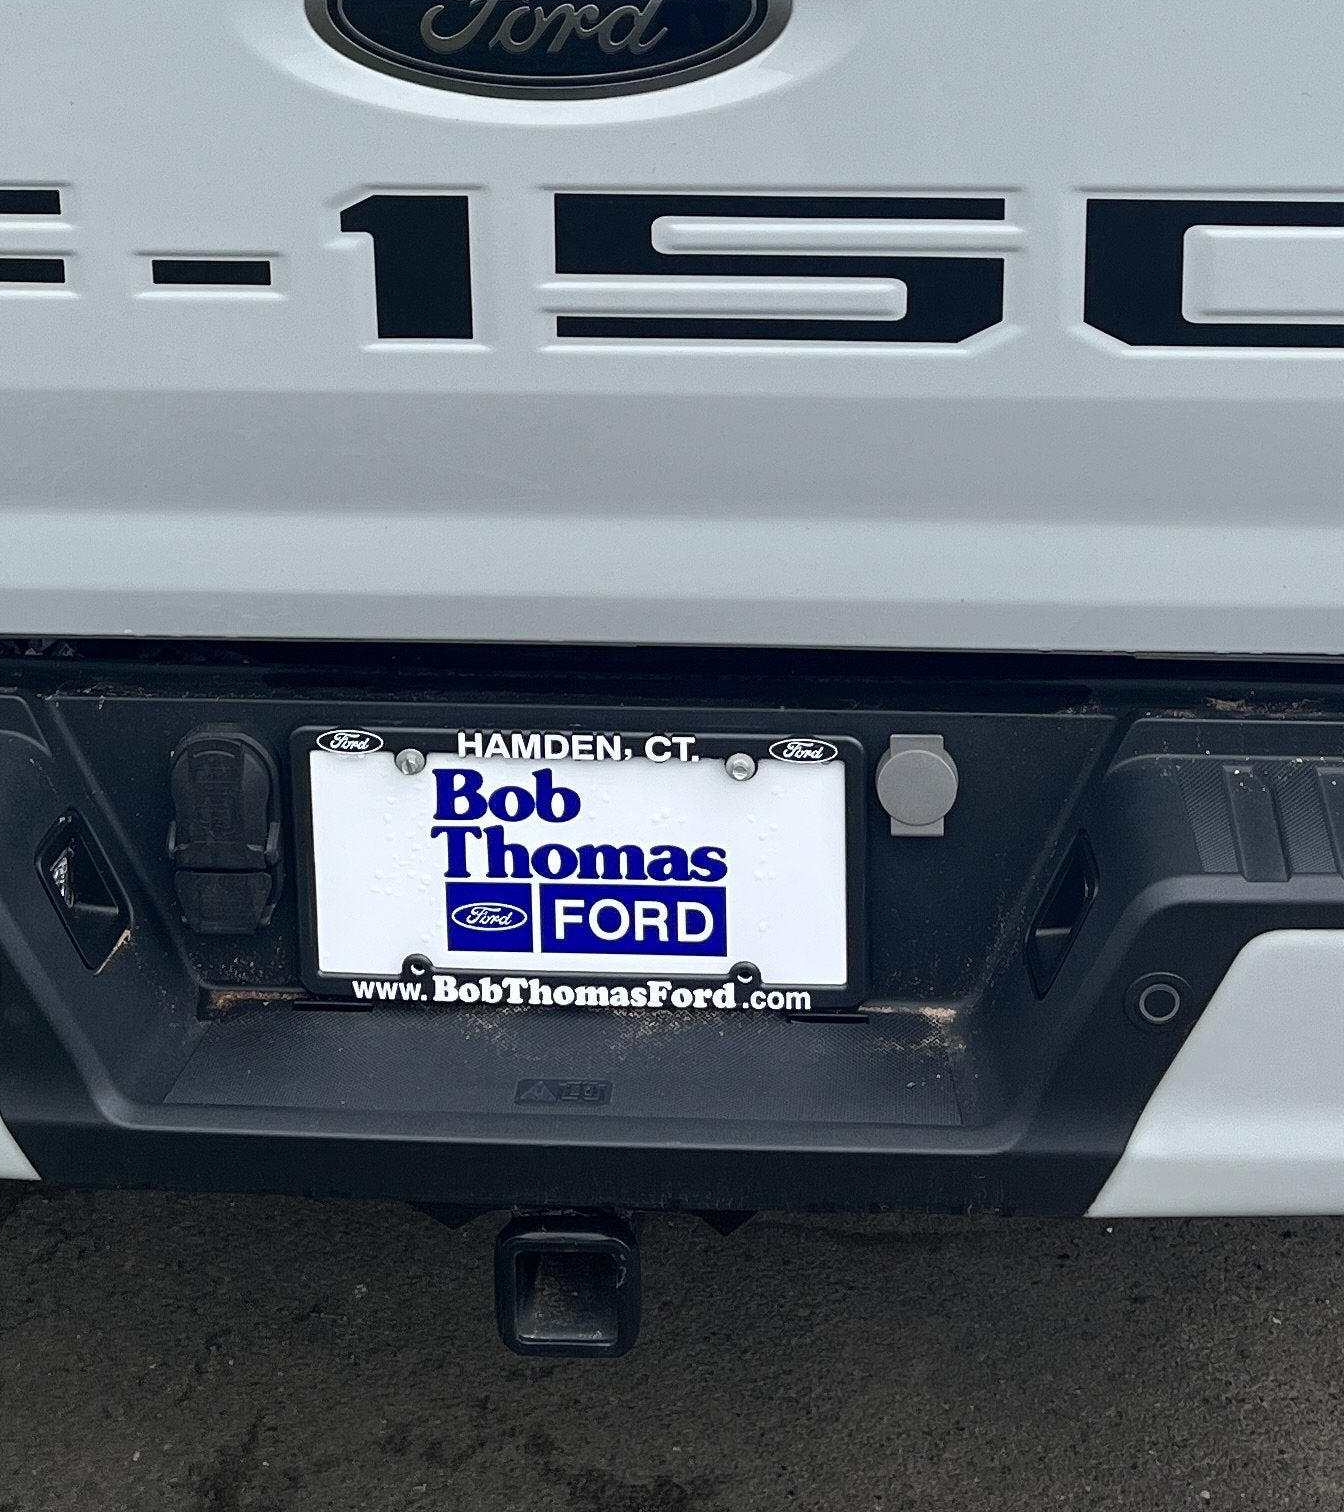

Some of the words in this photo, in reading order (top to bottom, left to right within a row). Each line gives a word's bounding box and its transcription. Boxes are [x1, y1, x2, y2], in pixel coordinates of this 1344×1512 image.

[329, 732, 370, 751] Ford
[457, 732, 634, 763] HAMDEN,
[644, 735, 700, 763] CT.
[782, 741, 824, 759] Ford
[433, 768, 582, 823] Bob
[431, 825, 728, 882] Thomas
[466, 906, 513, 925] Ford
[554, 899, 714, 942] FORD
[352, 973, 812, 1012] www.BobThomasFord.com
